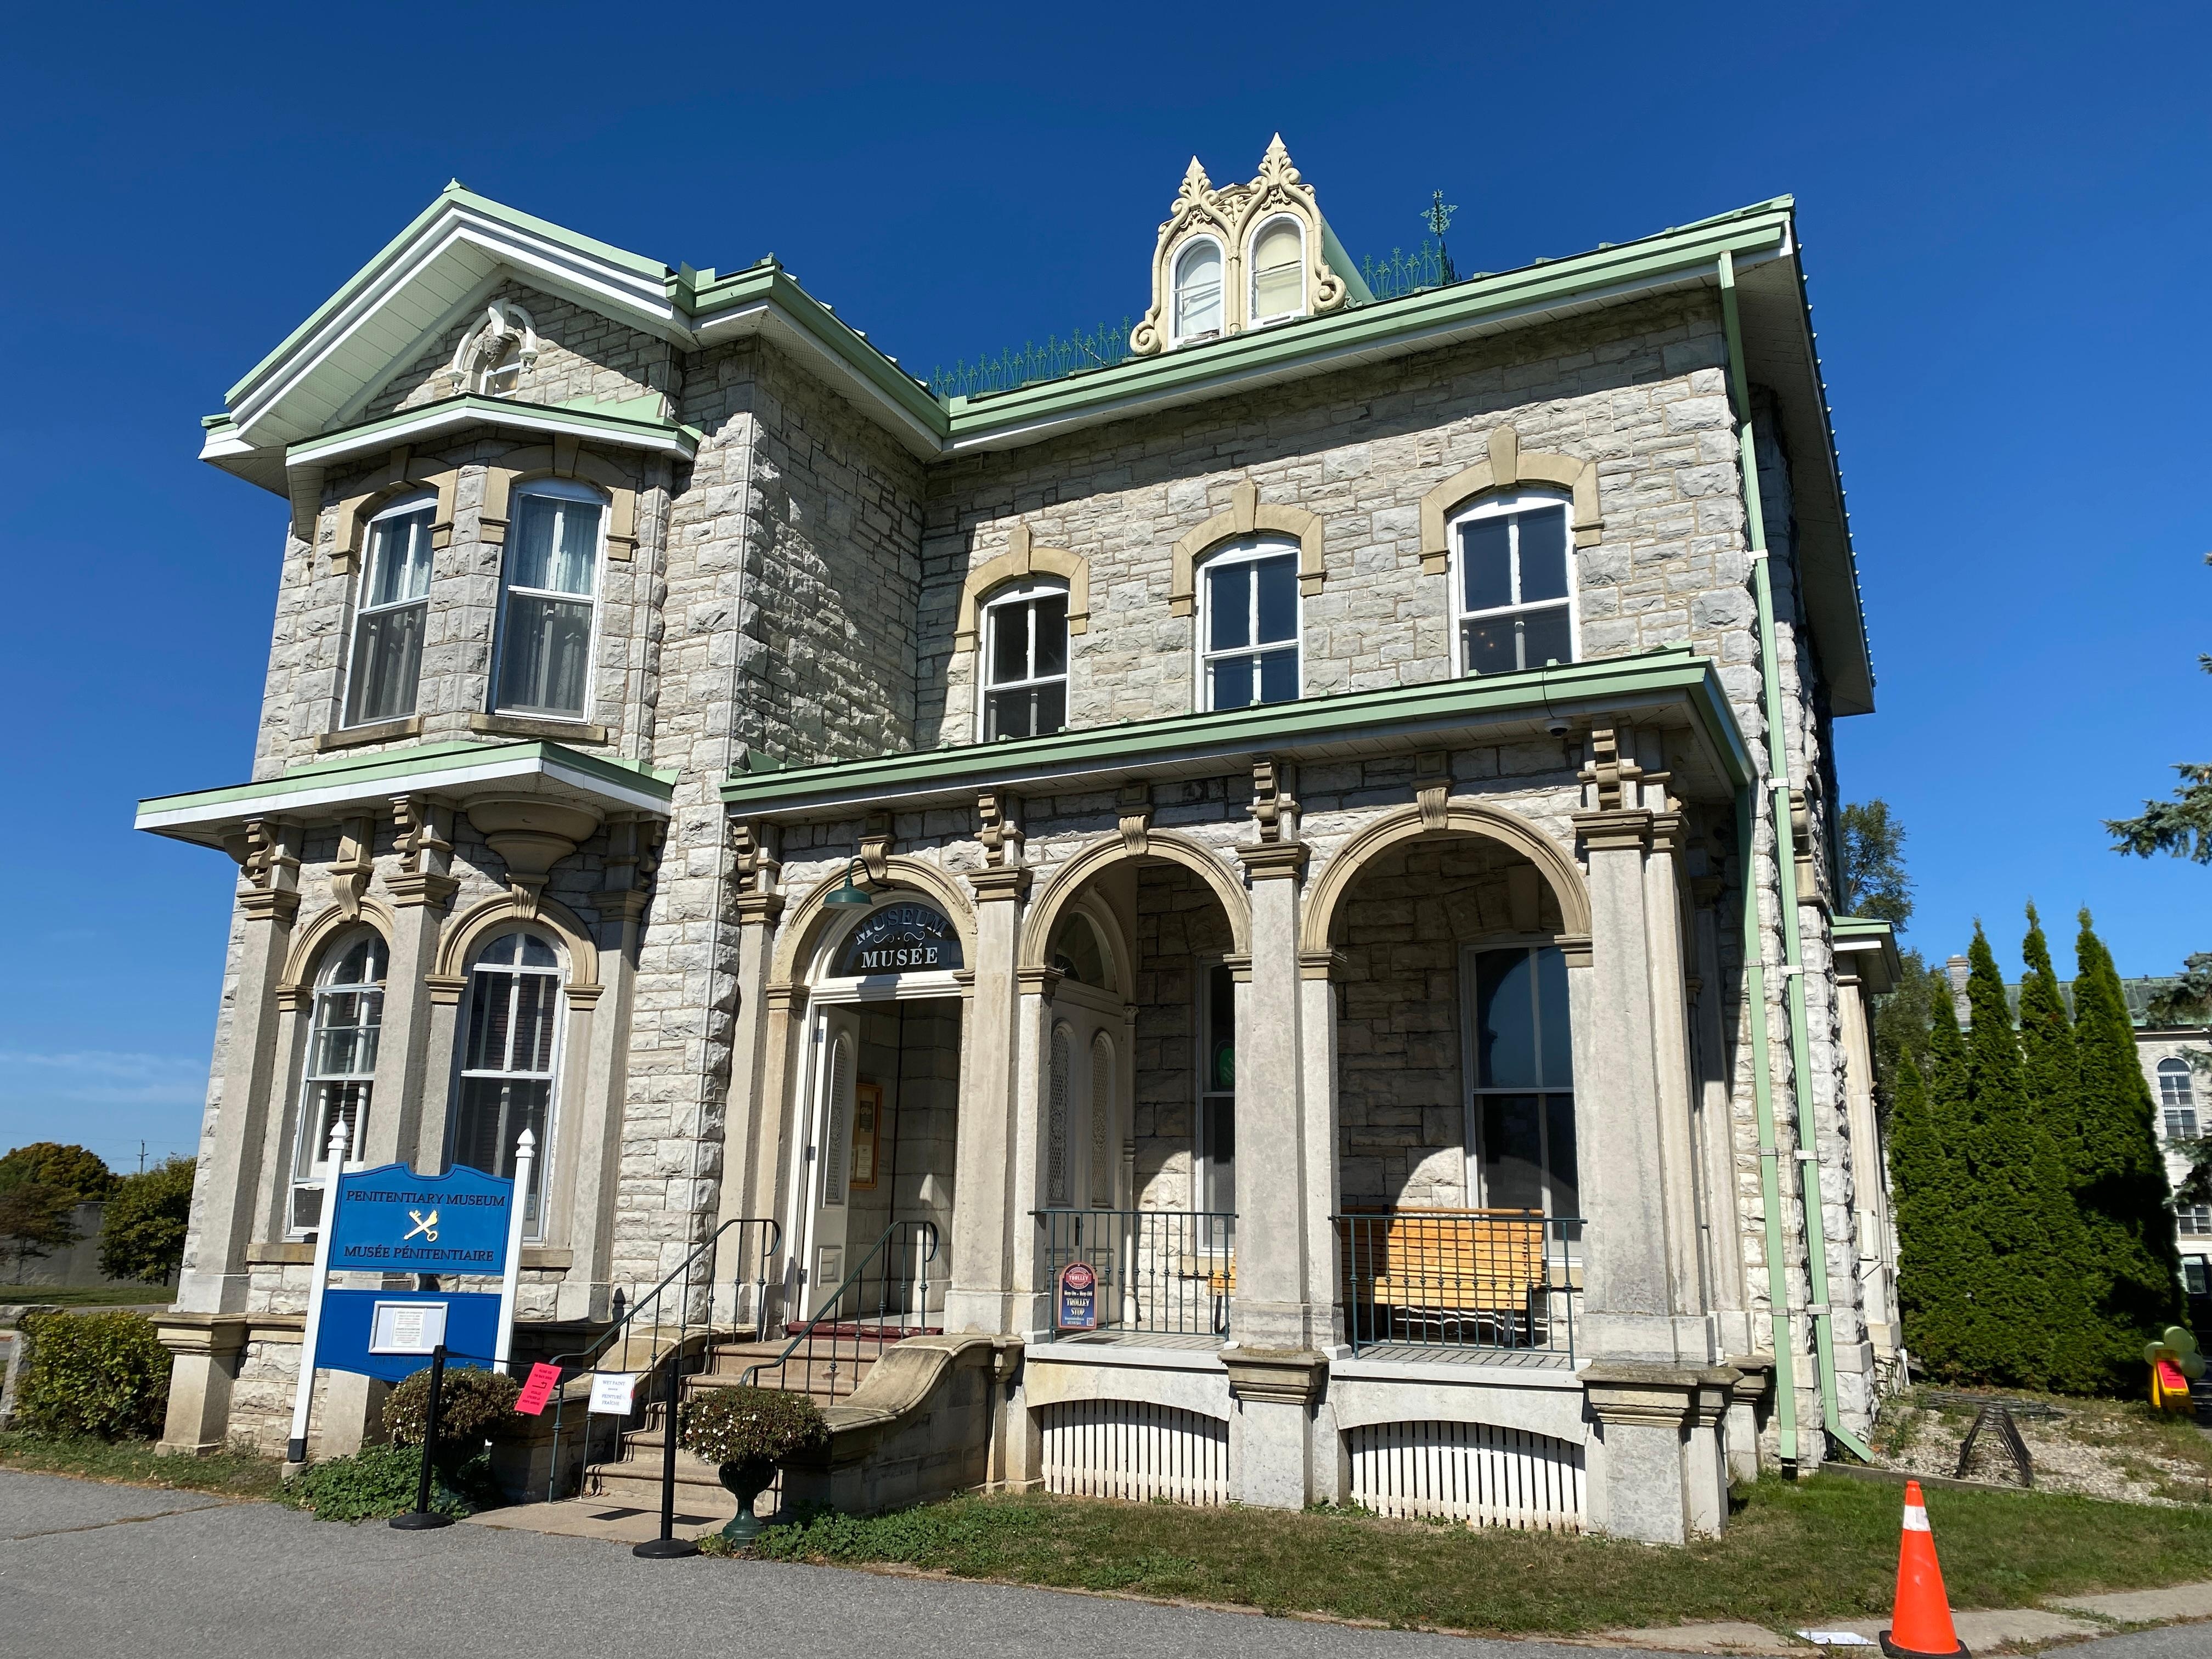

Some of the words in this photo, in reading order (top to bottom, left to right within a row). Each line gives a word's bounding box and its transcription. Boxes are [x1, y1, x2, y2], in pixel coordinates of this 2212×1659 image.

[853, 908, 949, 945] MUSEUM
[861, 943, 938, 968] MUSÉE
[346, 1190, 444, 1205] PENITENTIARY
[446, 1194, 505, 1206] MUSEUM
[344, 1244, 390, 1258] MUSÉE
[393, 1245, 494, 1262] PÉNITENTIAIRE
[1066, 1298, 1090, 1306] TROLLEY
[1071, 1307, 1085, 1316] STOP
